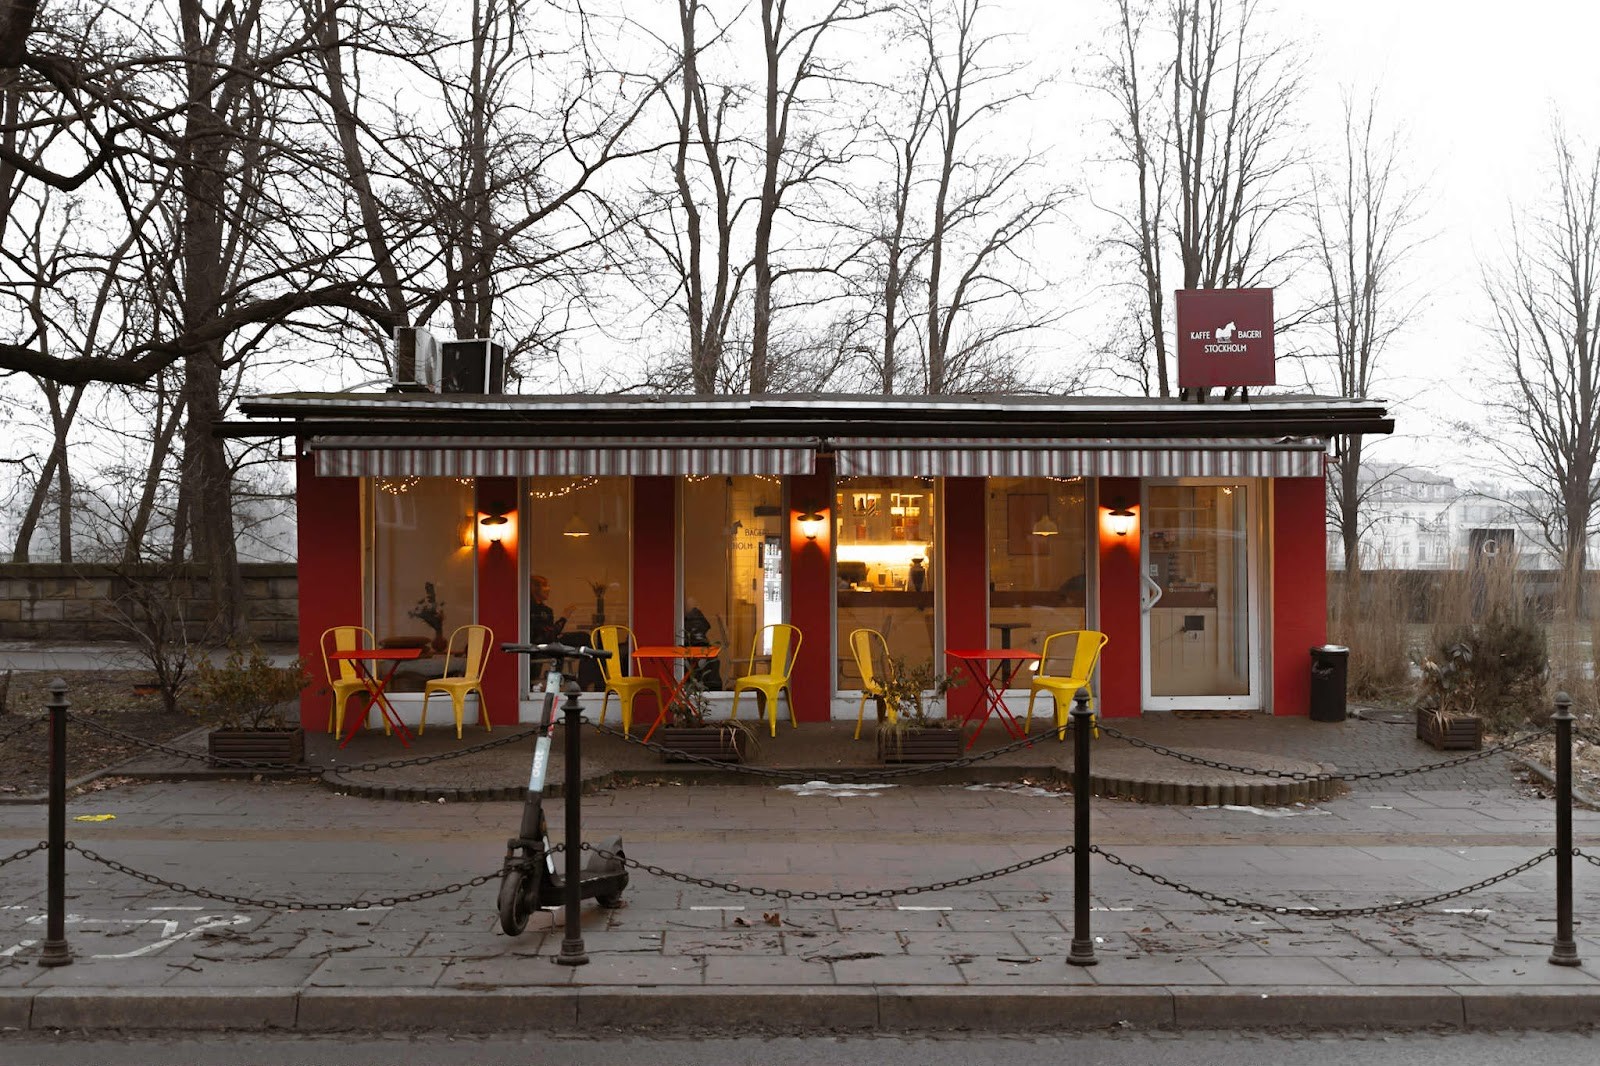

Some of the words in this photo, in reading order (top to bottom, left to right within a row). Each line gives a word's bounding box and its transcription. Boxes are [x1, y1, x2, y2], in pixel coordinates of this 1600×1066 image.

[1190, 331, 1210, 340] KAFFE
[1238, 330, 1262, 339] BAGERI
[1204, 344, 1247, 353] STOCKHOLM
